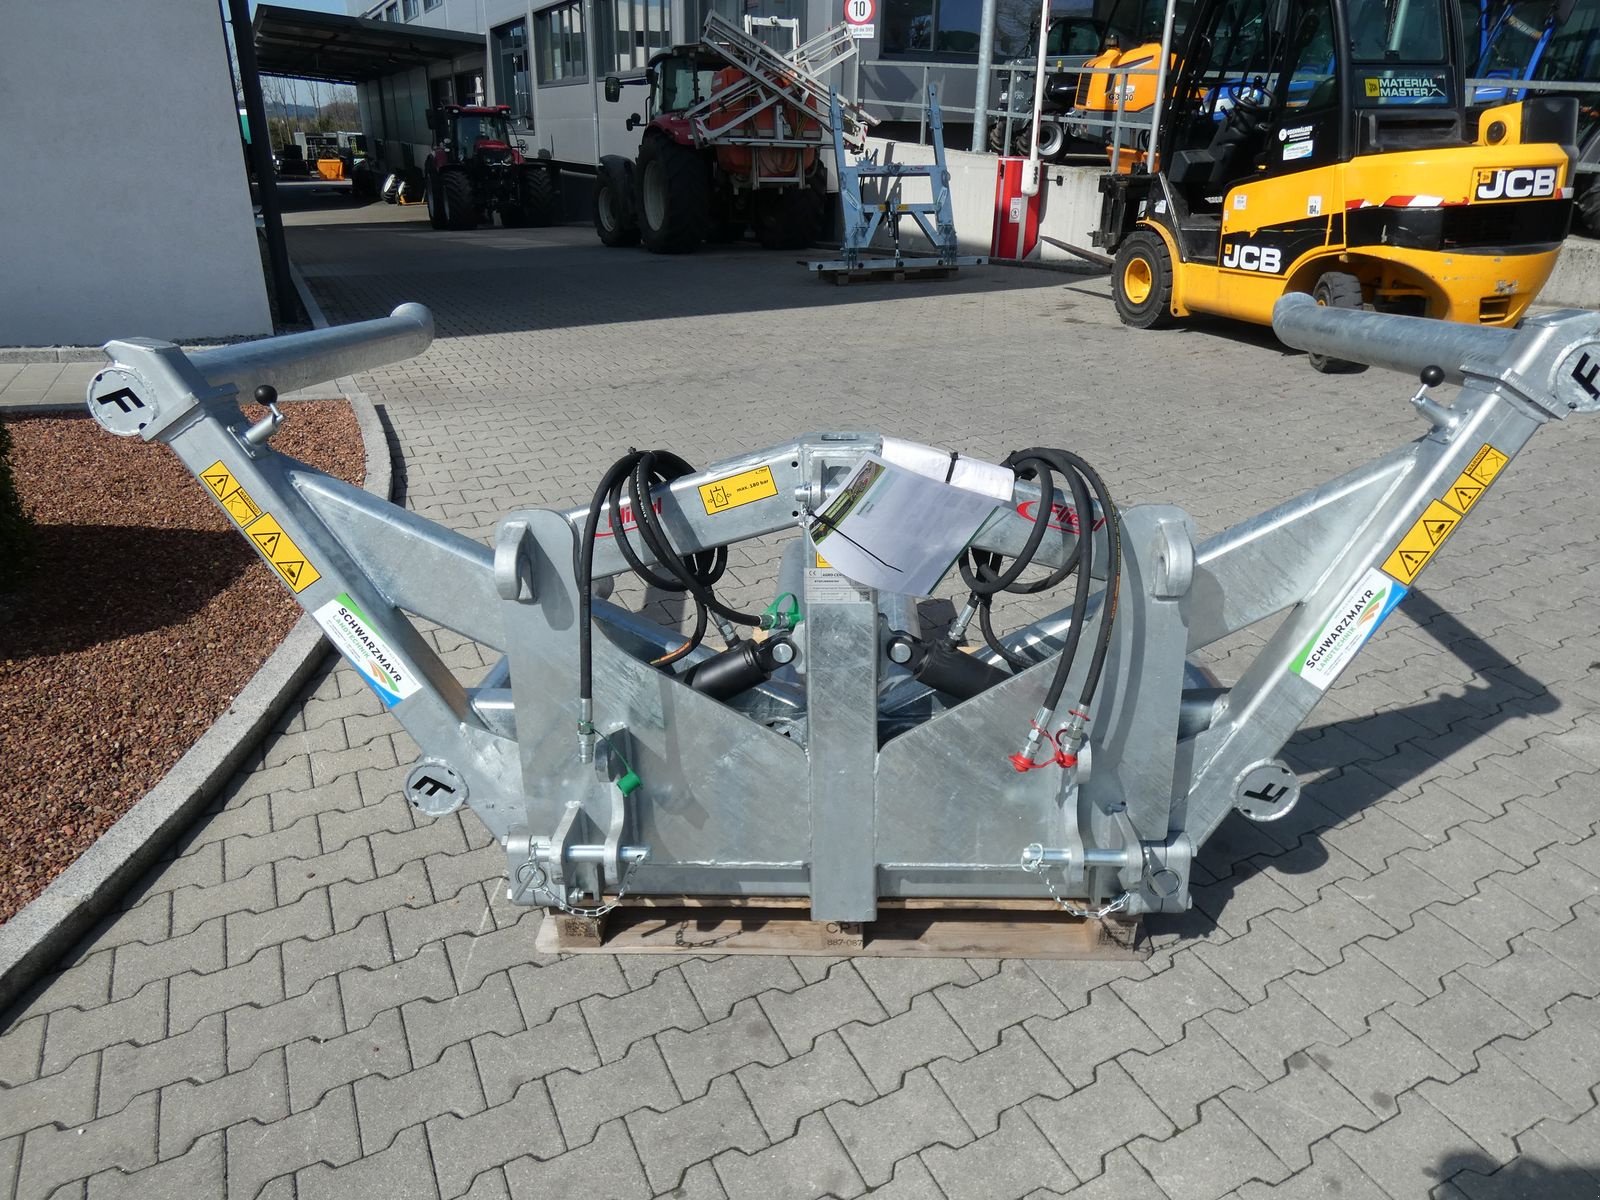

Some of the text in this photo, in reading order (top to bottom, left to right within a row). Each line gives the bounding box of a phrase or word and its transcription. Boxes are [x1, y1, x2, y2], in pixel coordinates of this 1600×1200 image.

[854, 1, 866, 16] 10
[1379, 78, 1437, 88] MATERIAL
[1380, 88, 1429, 97] MASTER
[1477, 169, 1556, 199] JCB
[1223, 245, 1282, 273] JCB
[96, 387, 146, 414] F
[1050, 503, 1106, 532] Fliel
[1306, 589, 1374, 668] SCHWARZMAYR
[338, 607, 402, 683] SCHWARZMAYR
[1316, 626, 1357, 671] LANDTECHNIK
[411, 775, 456, 797] F
[1243, 783, 1289, 804] F
